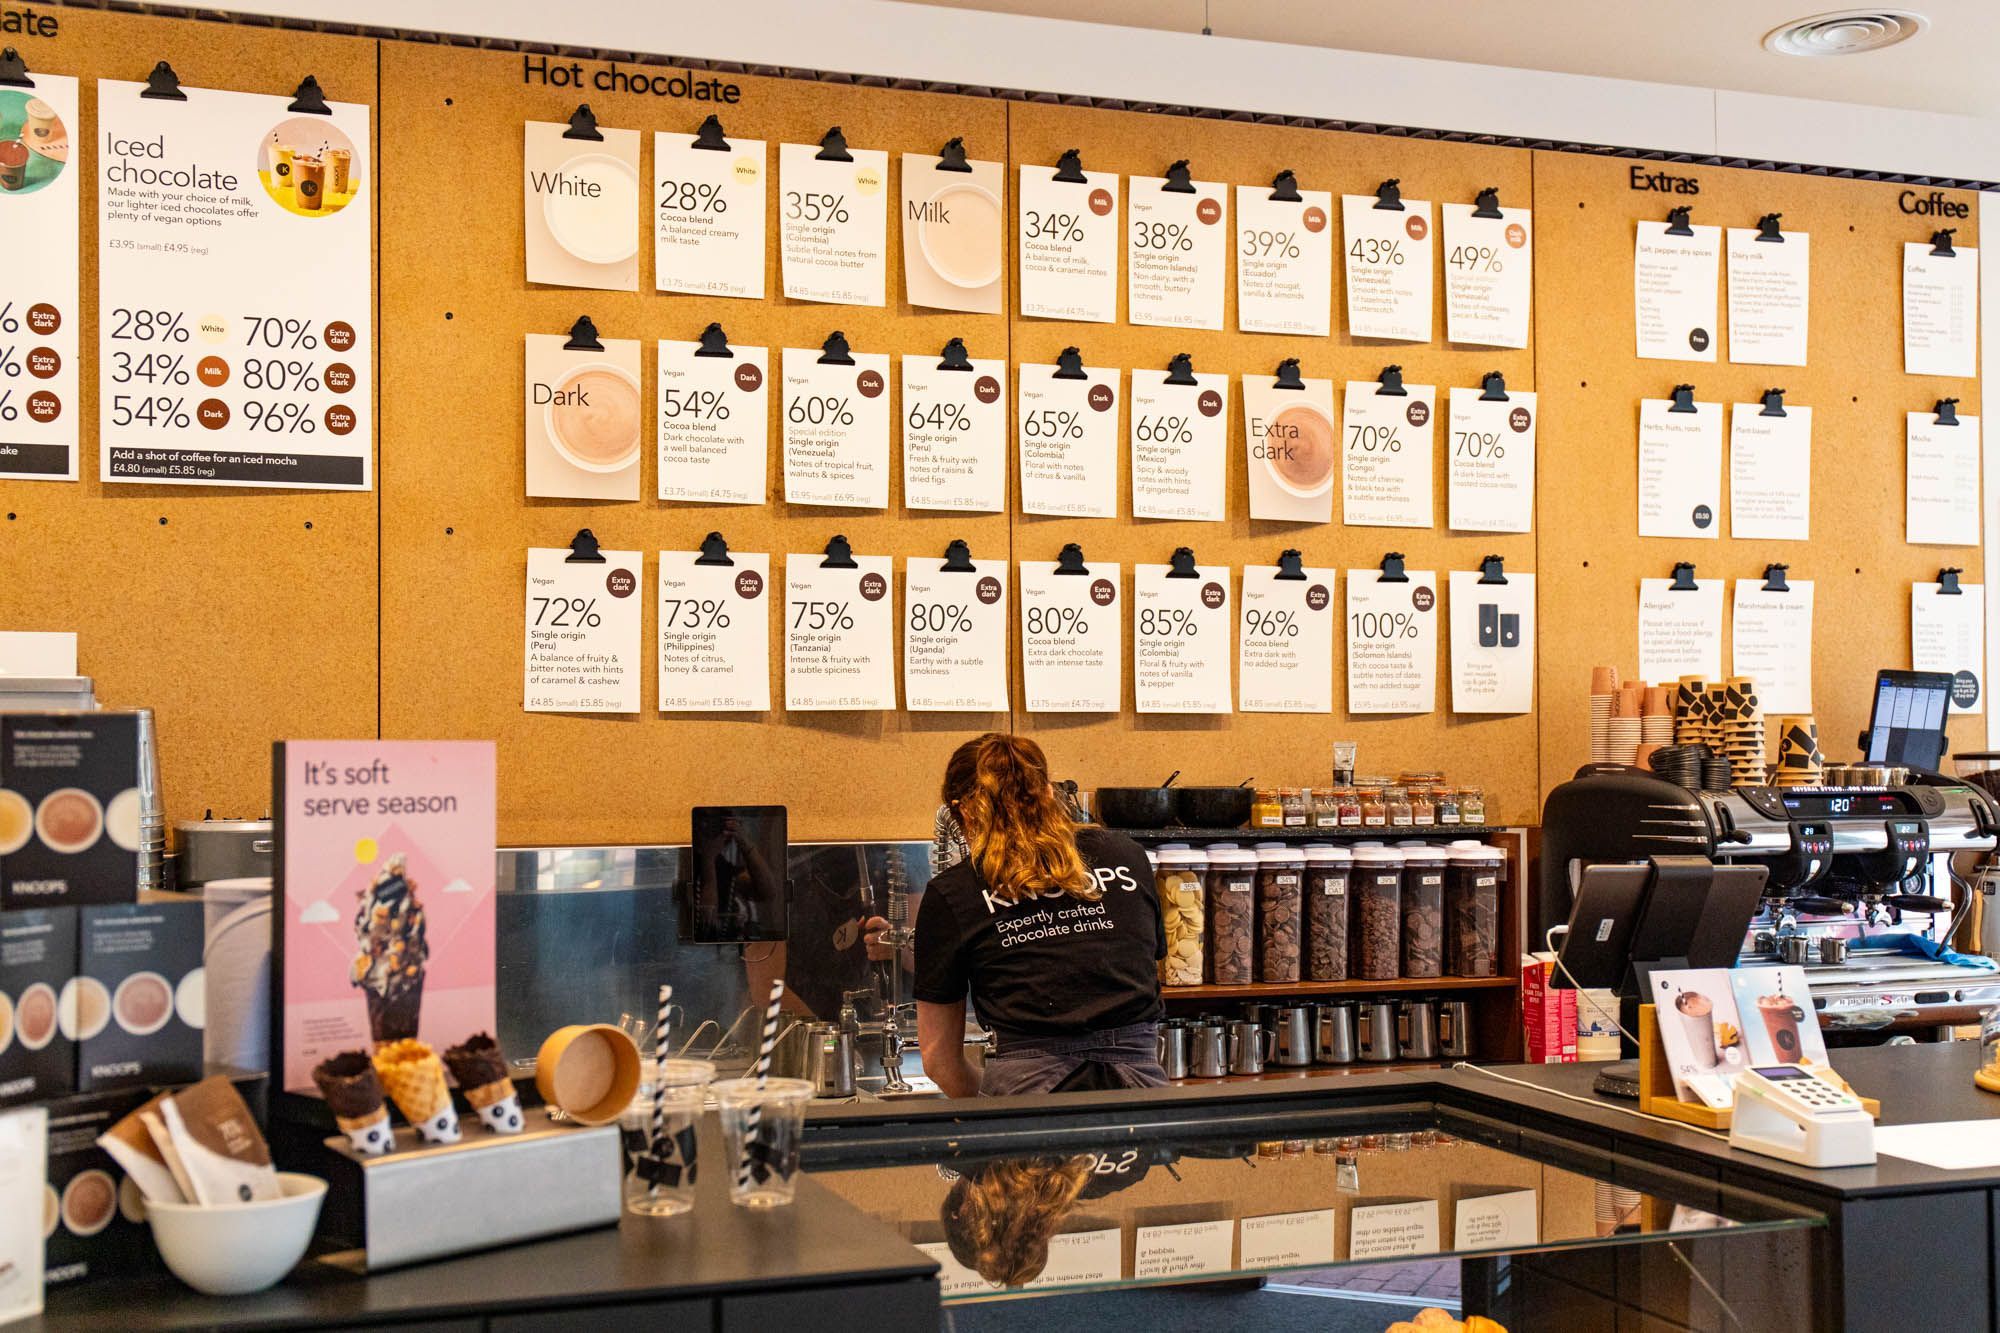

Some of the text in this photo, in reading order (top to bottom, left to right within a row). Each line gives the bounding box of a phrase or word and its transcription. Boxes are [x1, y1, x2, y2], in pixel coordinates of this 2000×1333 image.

[523, 56, 740, 104] Hot chocolate
[108, 132, 163, 159] Iced
[107, 159, 237, 191] chocolate
[531, 171, 601, 197] White
[1630, 166, 1699, 195] Extras
[108, 187, 253, 207] Made with your choice of milk,
[127, 199, 158, 214] lighter
[161, 203, 181, 212] iced
[184, 204, 234, 215] chocolates
[237, 208, 259, 217] offer
[661, 181, 726, 213] 28%
[787, 192, 848, 223] 35%
[1898, 190, 1969, 219] Coffee
[108, 211, 222, 227] plenty of vegan options
[660, 212, 713, 224] Cocoa blend
[909, 200, 950, 224] Milk
[1026, 211, 1084, 241] 34%
[1134, 222, 1192, 251] 38%
[109, 239, 208, 256] £3.95 (small) £4.95 (reg)
[1243, 230, 1299, 258] 39%
[1350, 238, 1404, 265] 43%
[1450, 246, 1502, 272] 49%
[112, 309, 189, 342] 28%
[244, 317, 317, 349] 70%
[330, 329, 350, 338] Extra
[331, 336, 350, 344] dark
[112, 352, 189, 385] 34%
[244, 359, 319, 392] 80%
[330, 371, 350, 379] Extra
[664, 370, 684, 378] Vegan
[331, 378, 348, 386] dark
[534, 383, 589, 406] Dark
[112, 395, 223, 428] 54% Dark
[244, 401, 315, 433] 96%
[330, 413, 350, 421] Extra
[664, 389, 729, 419] 54%
[789, 396, 853, 425] 60%
[909, 403, 970, 431] 64%
[664, 421, 716, 431] Cocoa blend
[1025, 410, 1083, 438] 65%
[1137, 416, 1192, 443] 66%
[1252, 418, 1299, 438] Extra
[664, 433, 683, 441] Dark
[685, 434, 725, 443] chocolate
[670, 444, 687, 452] well
[689, 444, 727, 454] balanced
[1349, 425, 1401, 452] 70%
[1455, 432, 1504, 458] 70%
[113, 450, 134, 459] Add
[145, 451, 167, 460] shot
[169, 452, 179, 461] of
[181, 452, 211, 462] coffee
[213, 453, 227, 462] for
[243, 455, 263, 464] iced
[266, 456, 297, 465] mocha
[1253, 441, 1295, 462] dark
[113, 463, 215, 477] £4.80 (small) £5.85 (reg)
[532, 578, 554, 586] Vegan
[533, 597, 600, 627] 72%
[665, 600, 730, 628] 73%
[792, 602, 853, 630] 75%
[911, 604, 972, 632] 80%
[1028, 607, 1088, 634] 80%
[1140, 609, 1197, 636] 85%
[1246, 610, 1298, 636] 96%
[531, 630, 585, 641] Single origin
[664, 632, 716, 642] Single origin
[791, 633, 841, 643] Single origin
[1352, 613, 1418, 638] 100%
[531, 641, 556, 650] (Peru)
[531, 653, 538, 661] A
[540, 653, 574, 662] balance
[576, 654, 585, 662] of
[587, 654, 609, 664] fruity
[664, 643, 714, 652] (Philippines)
[664, 654, 726, 663] Notes of citrus,
[791, 644, 831, 652] (Tanzania)
[531, 664, 554, 672] bitter
[603, 665, 623, 673] hints
[542, 676, 576, 684] caramel
[588, 677, 619, 685] cashew
[664, 666, 690, 675] honey
[701, 665, 733, 673] caramel
[305, 758, 390, 786] It's soft
[304, 796, 457, 816] serve season
[1831, 799, 1849, 812] 120
[996, 902, 1105, 934] Expertly crafted
[1001, 918, 1114, 947] chocolate drinks
